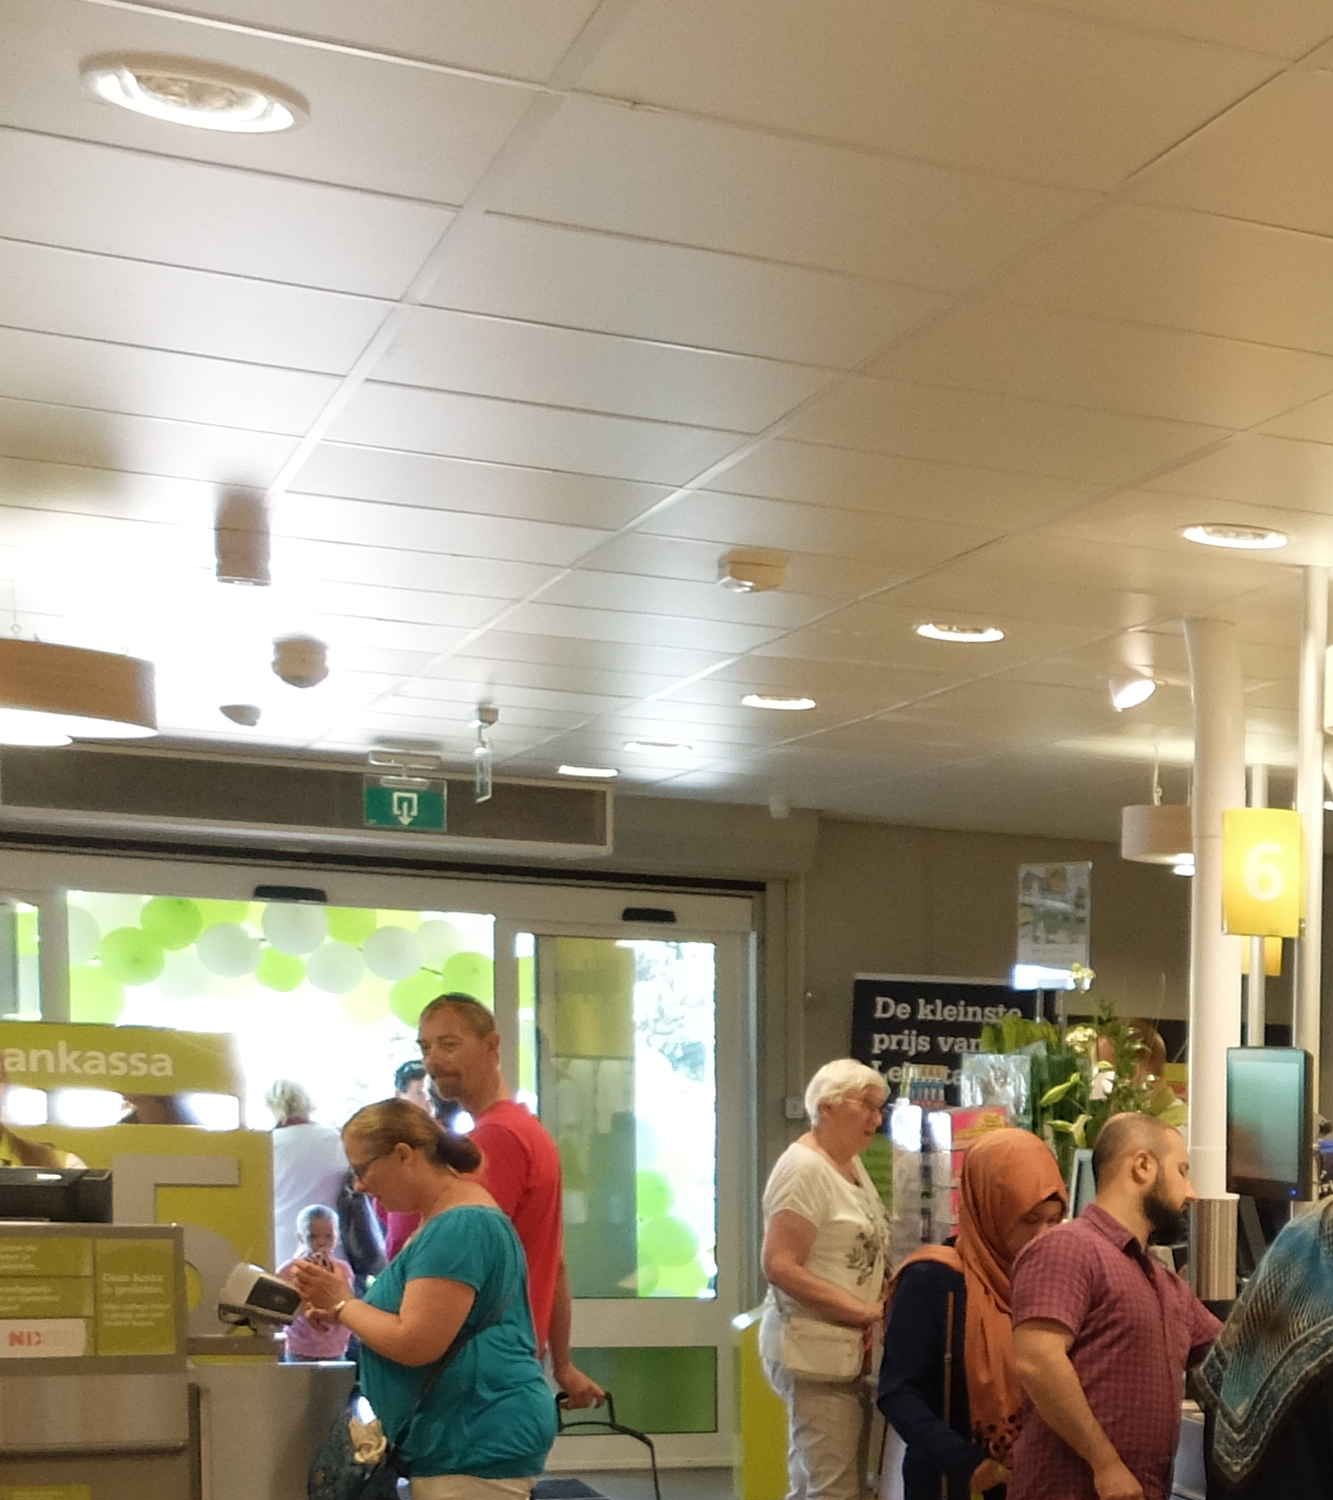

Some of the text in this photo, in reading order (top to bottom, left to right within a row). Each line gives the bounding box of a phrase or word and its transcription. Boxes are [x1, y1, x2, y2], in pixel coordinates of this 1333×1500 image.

[1244, 841, 1285, 901] 6
[874, 996, 1022, 1023] De kleinste
[872, 1029, 931, 1057] prijs
